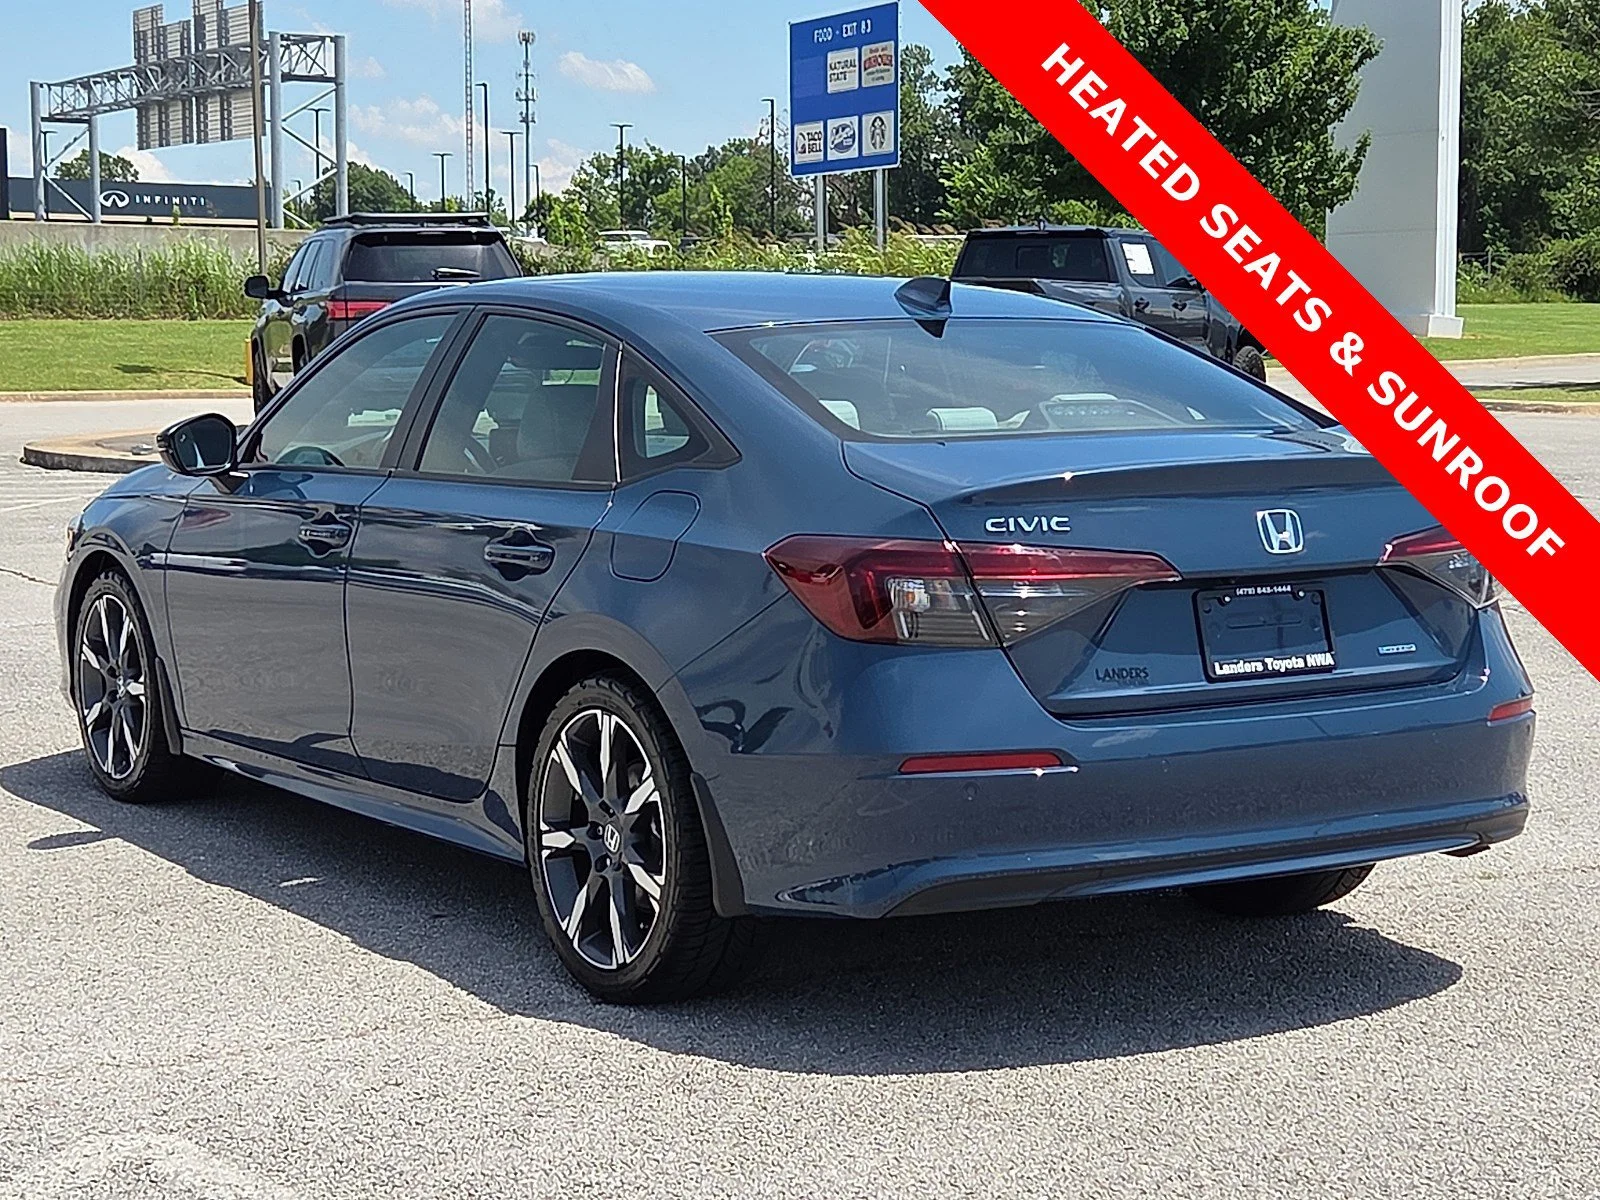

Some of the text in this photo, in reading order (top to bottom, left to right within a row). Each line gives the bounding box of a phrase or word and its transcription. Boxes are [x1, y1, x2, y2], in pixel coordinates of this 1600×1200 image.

[829, 58, 857, 71] NATURAL
[829, 71, 848, 83] STATE
[806, 130, 822, 142] TACO
[807, 142, 822, 154] BELL
[135, 194, 205, 206] INFINITI
[985, 516, 1071, 532] CIVIC
[1214, 652, 1335, 675] Landers Toyota NWA
[1094, 666, 1150, 682] LANDERS
